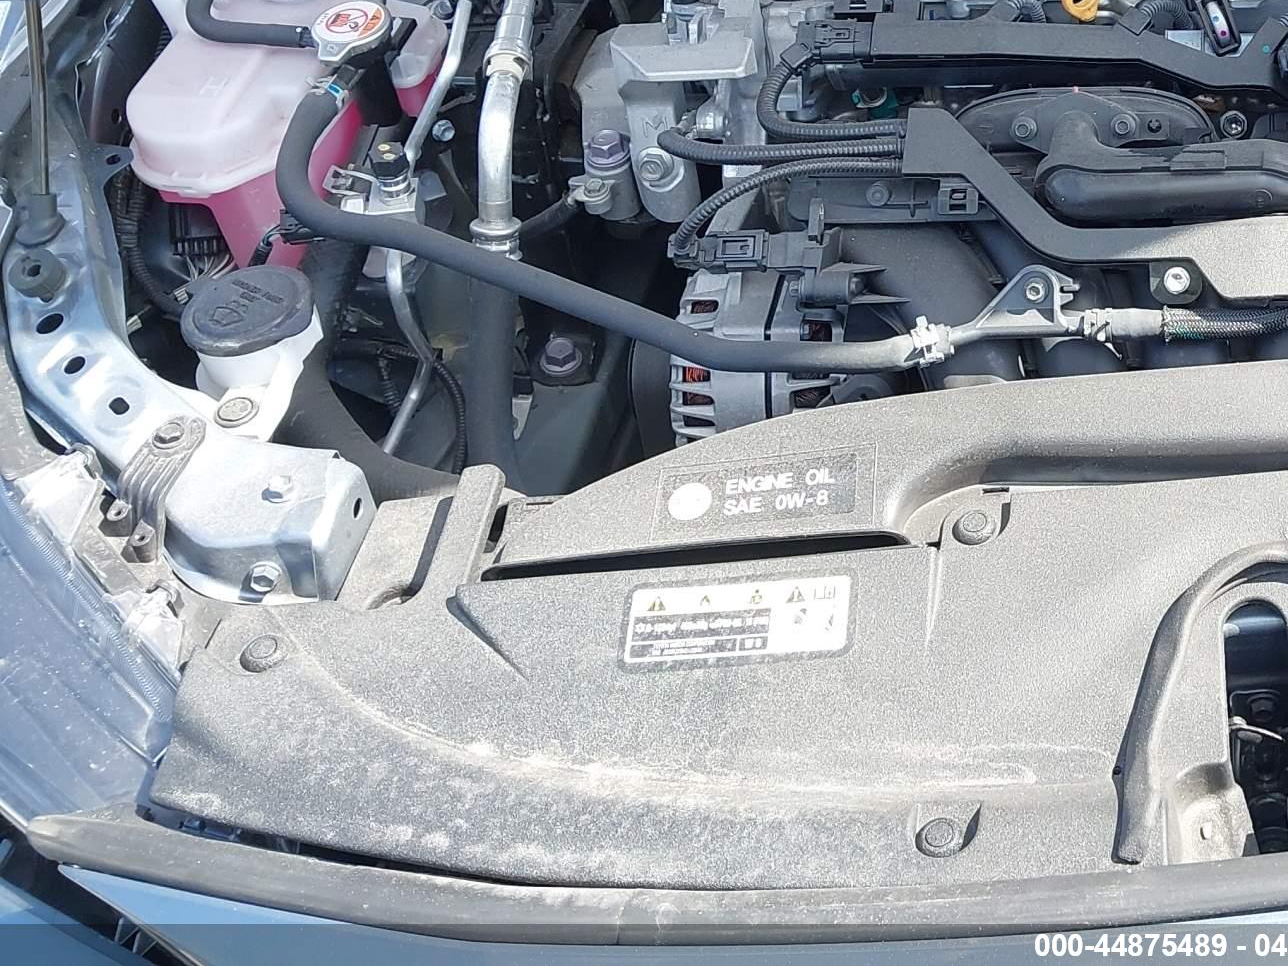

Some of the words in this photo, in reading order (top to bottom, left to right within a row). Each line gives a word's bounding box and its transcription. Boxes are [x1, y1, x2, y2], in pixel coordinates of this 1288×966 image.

[725, 472, 793, 494] ENGINE
[805, 467, 835, 486] OIL
[723, 496, 762, 515] SAE
[775, 489, 829, 511] 0W-8
